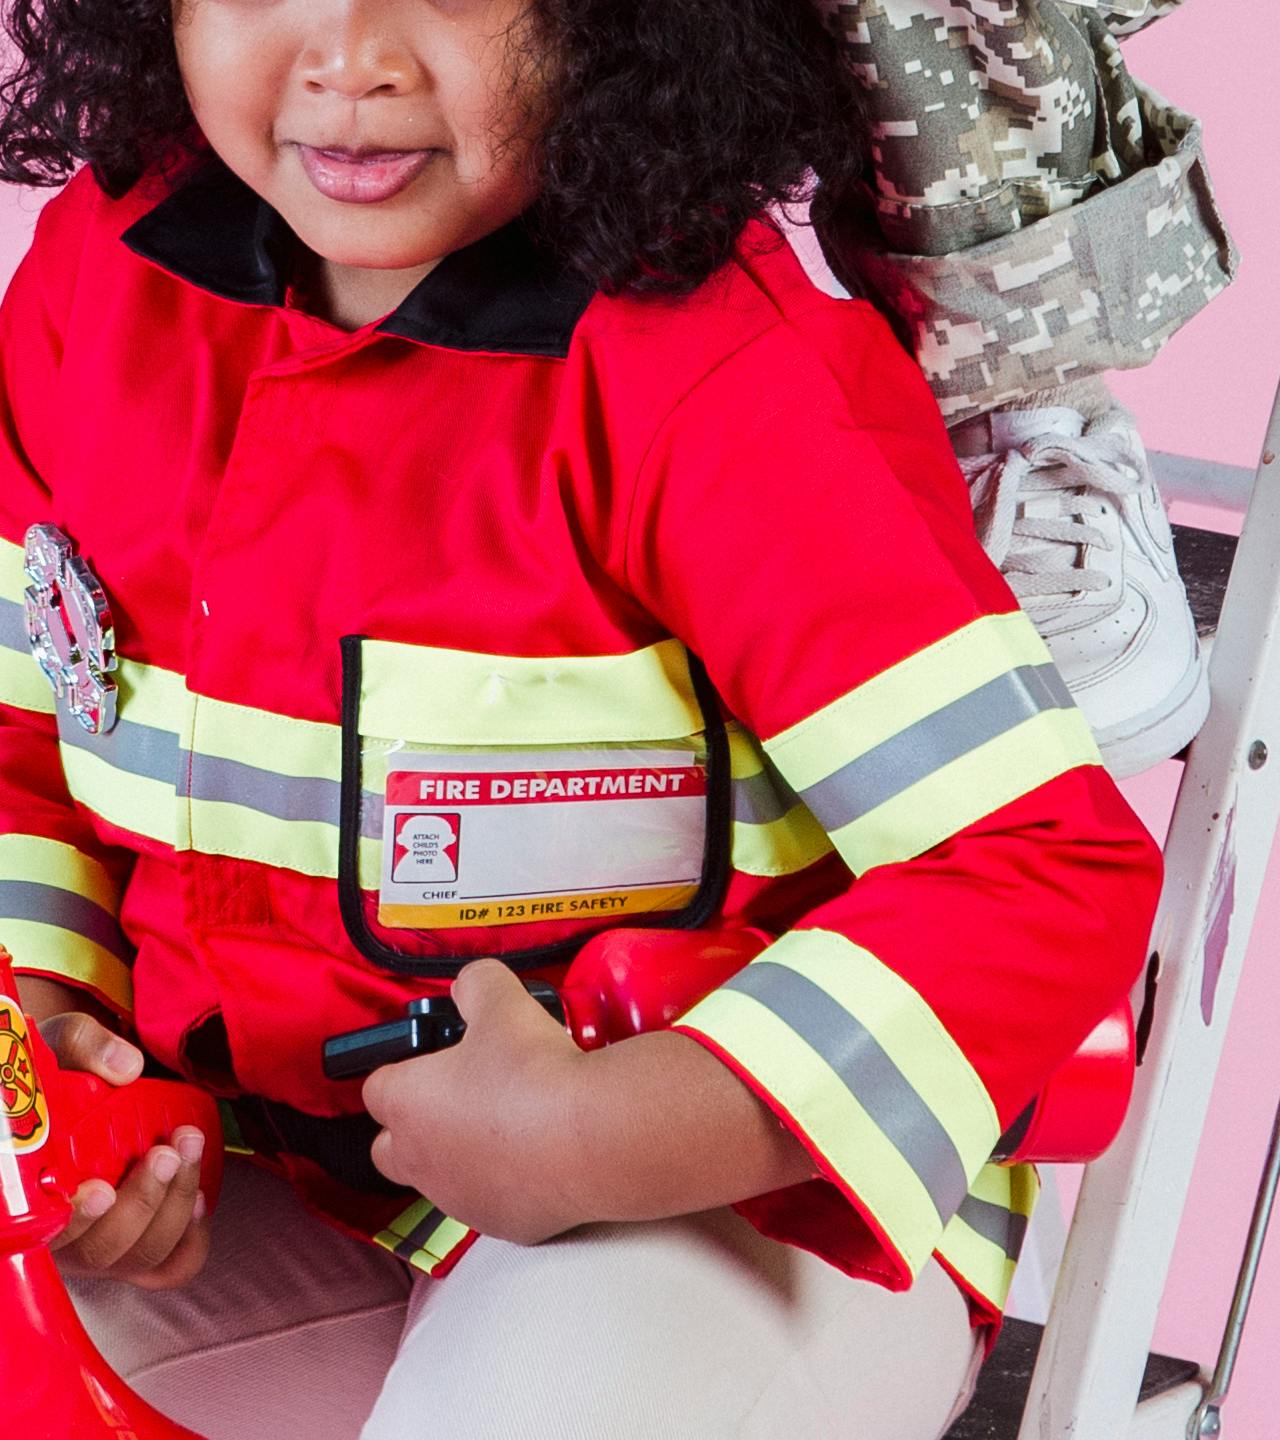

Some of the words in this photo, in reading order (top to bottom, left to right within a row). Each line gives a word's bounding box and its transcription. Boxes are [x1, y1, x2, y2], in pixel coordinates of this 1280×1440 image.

[419, 779, 481, 801] FIRE
[489, 773, 686, 801] DEPARTMENT
[412, 833, 440, 841] ATTACH
[412, 841, 439, 849] CHILD'S
[422, 890, 458, 900] CHIEF
[459, 906, 489, 920] ID#
[498, 905, 525, 918] 123
[531, 902, 564, 916] FIRE
[570, 896, 629, 911] SAFETY
